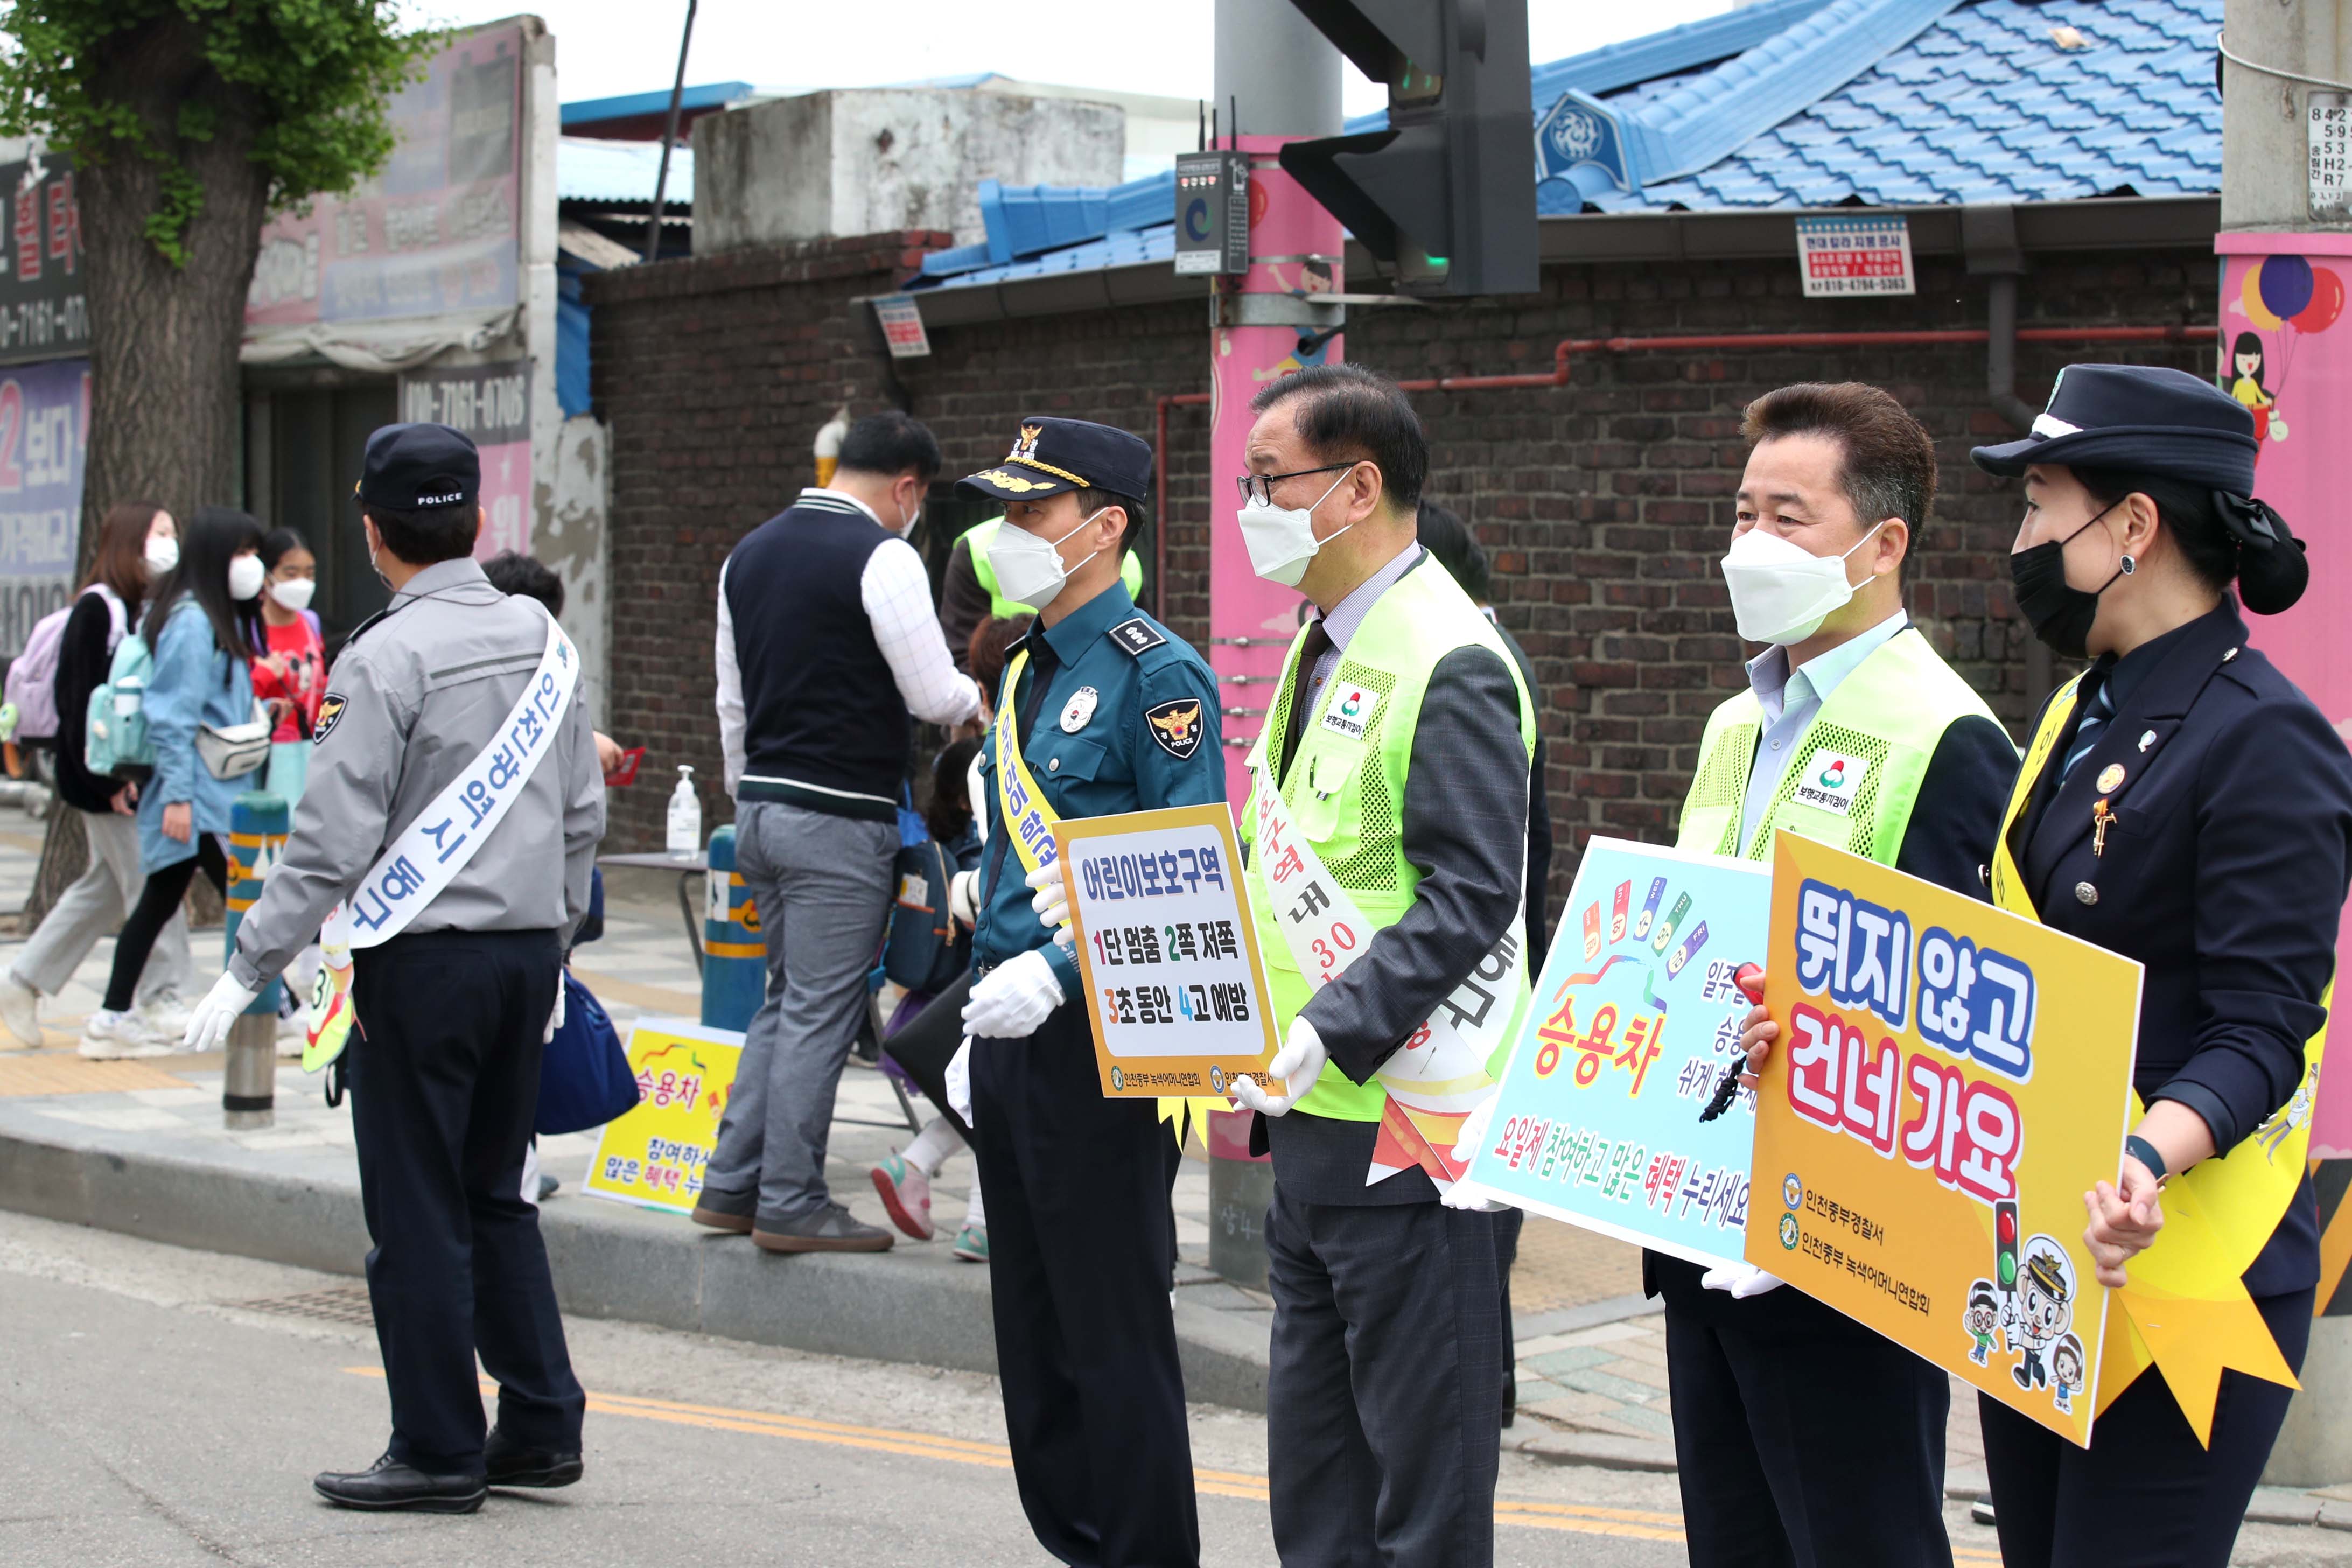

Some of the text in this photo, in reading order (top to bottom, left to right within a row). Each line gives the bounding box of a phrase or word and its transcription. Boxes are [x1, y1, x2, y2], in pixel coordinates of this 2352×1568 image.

[418, 492, 463, 505] POLICE
[1171, 737, 1194, 748] POLICE
[1326, 713, 1363, 736] 보행교통지킴이
[352, 671, 562, 931] 인천광역시 동구
[1798, 786, 1849, 810] 보행교통지킴이
[1082, 845, 1226, 901] 어린이보호구역
[1650, 879, 1660, 900] WED
[1287, 880, 1331, 925] 내
[1674, 894, 1687, 914] THU
[1612, 918, 1623, 934] 화
[1639, 914, 1649, 932] 수
[1692, 925, 1706, 942] FRI
[1094, 920, 1239, 966] 1단 멈춤 2쪽 저쪽
[1311, 922, 1356, 969] 30
[1672, 949, 1683, 969] 금
[1801, 887, 2031, 1069] 뛰지 않고
[1104, 982, 1250, 1024] 3초 동안 4고 예방
[1536, 997, 1665, 1094] 승용차
[636, 1069, 700, 1109] 승용차
[1124, 1072, 1202, 1087] 인천중부 녹색어머니연합회
[1678, 1060, 1715, 1099] 쉬게
[1793, 1012, 2017, 1194] 건너 가요
[605, 1157, 640, 1183] 많은
[645, 1165, 681, 1193] 혜택
[1494, 1117, 1750, 1227] 요일제 참여하고 많은 혜택 누리세요
[1806, 1189, 1884, 1247] 인천중부경찰서
[1802, 1232, 1930, 1317] 인천중부 녹색어머니연합회
